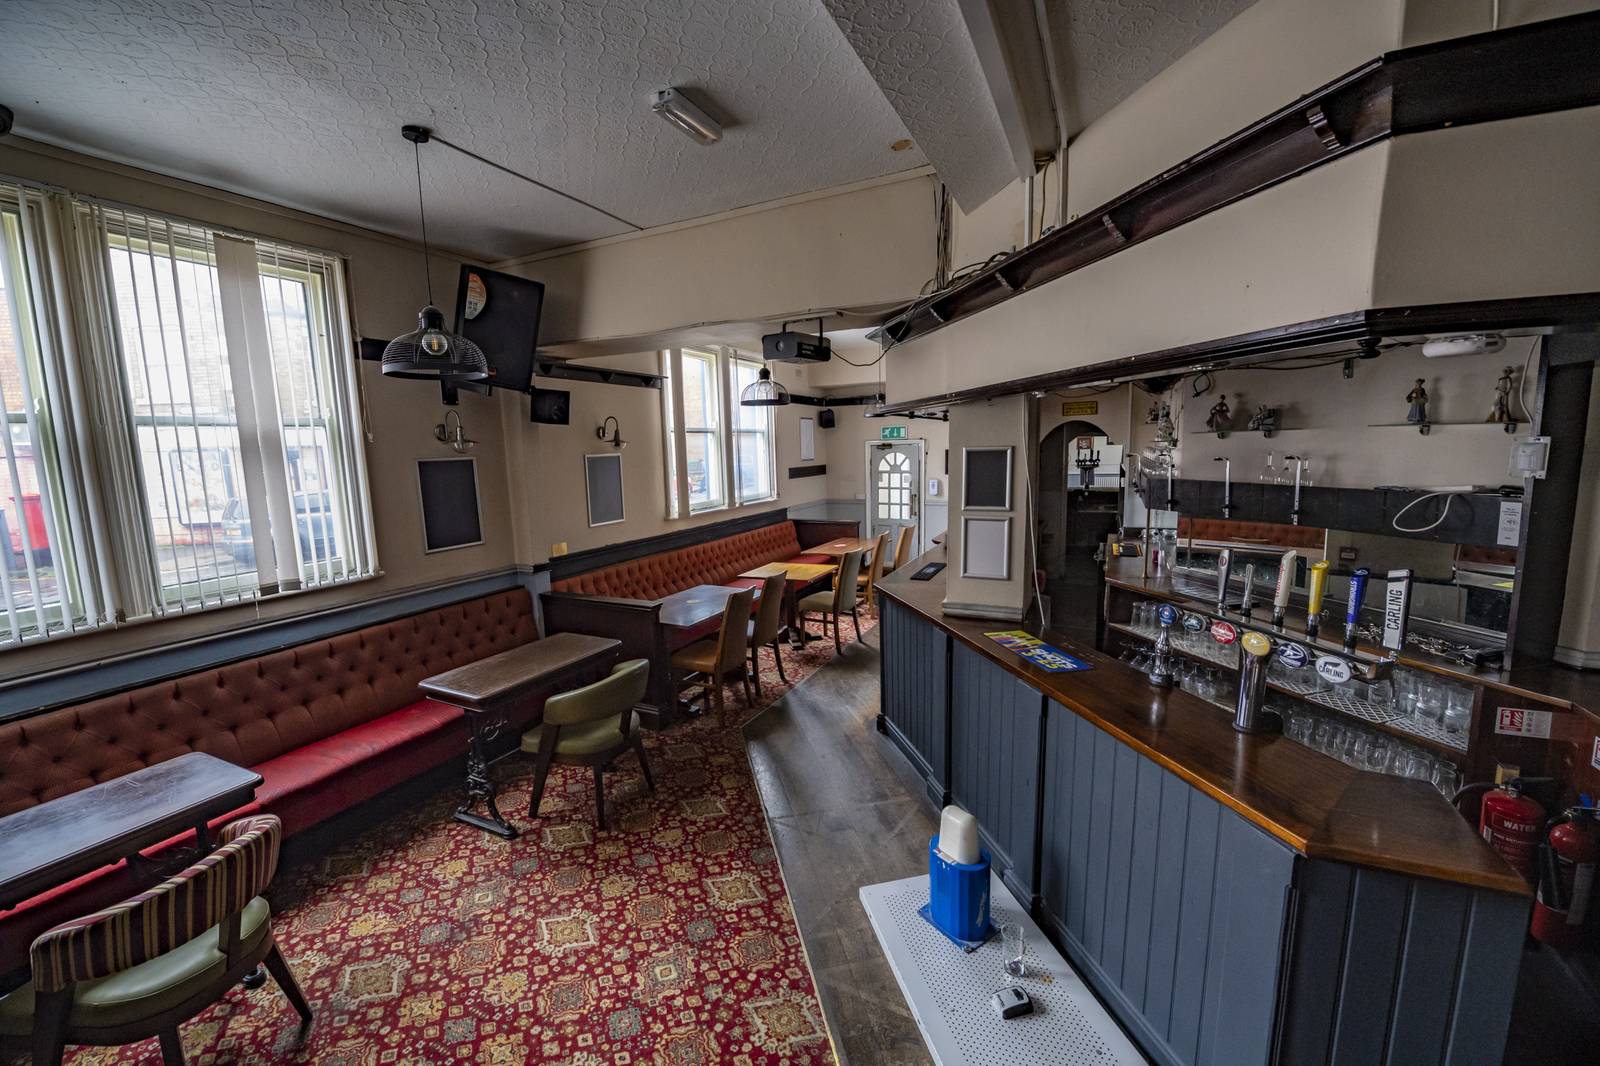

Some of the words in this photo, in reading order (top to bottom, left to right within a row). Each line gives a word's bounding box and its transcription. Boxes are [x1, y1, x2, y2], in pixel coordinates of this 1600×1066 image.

[1386, 589, 1403, 630] CARLING
[1318, 665, 1344, 678] CARLING
[1503, 820, 1536, 832] WATER
